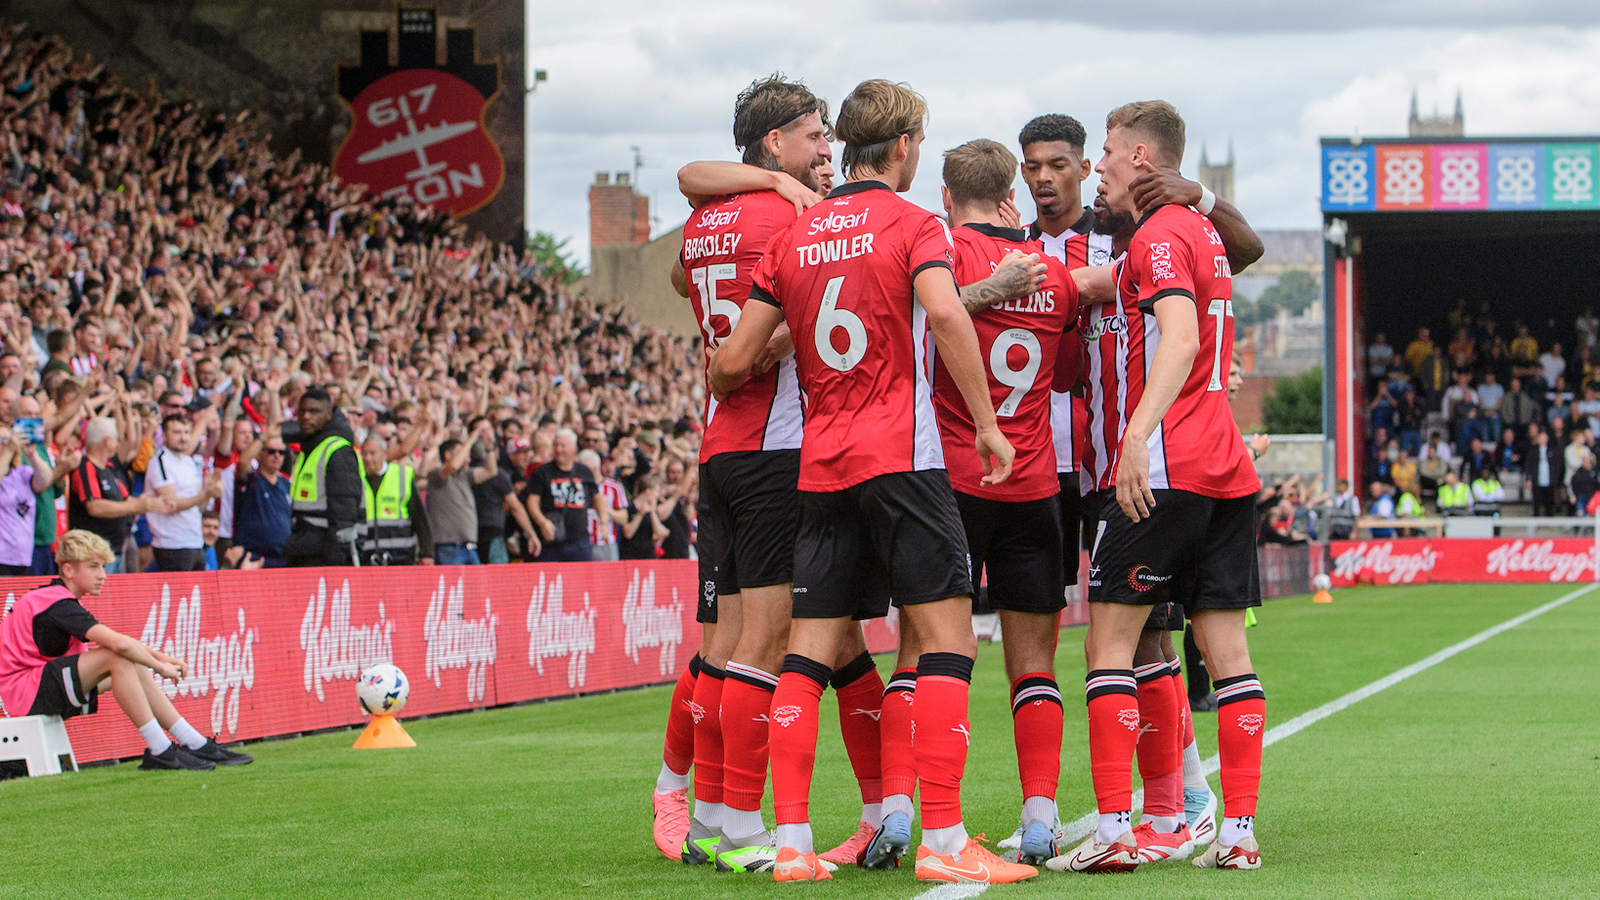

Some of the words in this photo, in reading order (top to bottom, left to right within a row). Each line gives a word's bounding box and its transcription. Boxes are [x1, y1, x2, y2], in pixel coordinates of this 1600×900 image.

[684, 233, 742, 260] BRADLEY
[697, 206, 742, 230] Solgari
[797, 233, 874, 268] TOWLER
[807, 208, 870, 236] Solgari
[691, 263, 742, 350] 15
[815, 276, 868, 372] 6
[990, 328, 1042, 417] 9
[424, 574, 497, 703] Kellogg's
[526, 570, 596, 689] Kellogg's
[622, 567, 683, 677] Kellogg's
